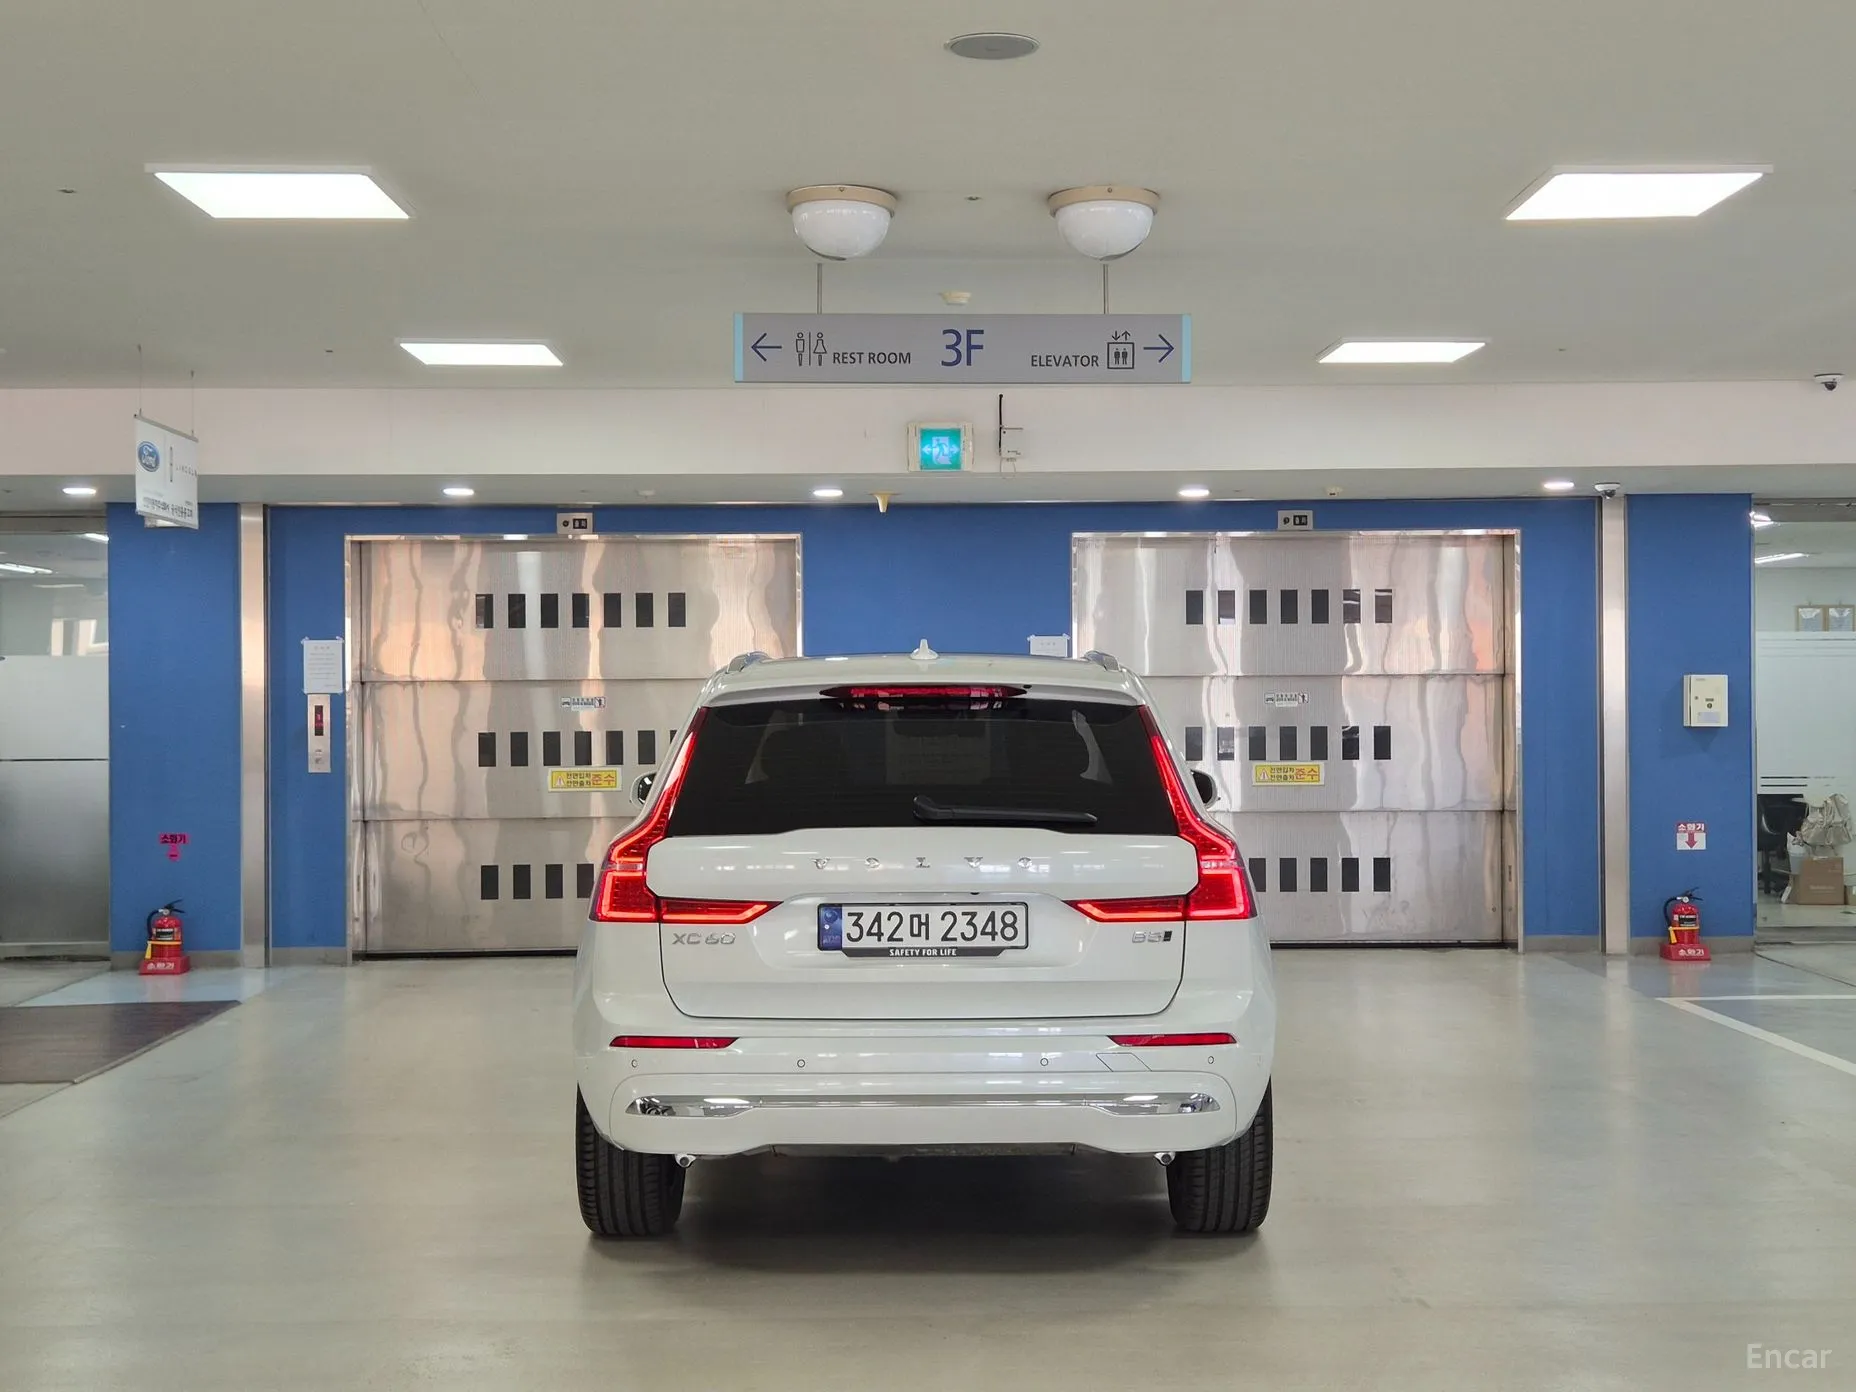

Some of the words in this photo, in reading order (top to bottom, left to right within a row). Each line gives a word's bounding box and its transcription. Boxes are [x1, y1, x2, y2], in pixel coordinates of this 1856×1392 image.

[941, 328, 985, 367] 3F
[832, 351, 864, 365] REST
[868, 351, 911, 365] ROOM
[1030, 354, 1099, 368] ELEVATOR
[591, 773, 615, 786] 준수
[1295, 767, 1318, 780] 준수
[1677, 822, 1705, 832] 소화기
[160, 833, 187, 844] 소화기
[811, 856, 1032, 870] VOLVO
[846, 910, 930, 943] 342머
[940, 910, 1019, 942] 2348
[889, 948, 920, 957] SAFETY
[922, 948, 937, 957] FOR
[940, 948, 957, 957] LIFE
[1678, 948, 1705, 957] 소화기
